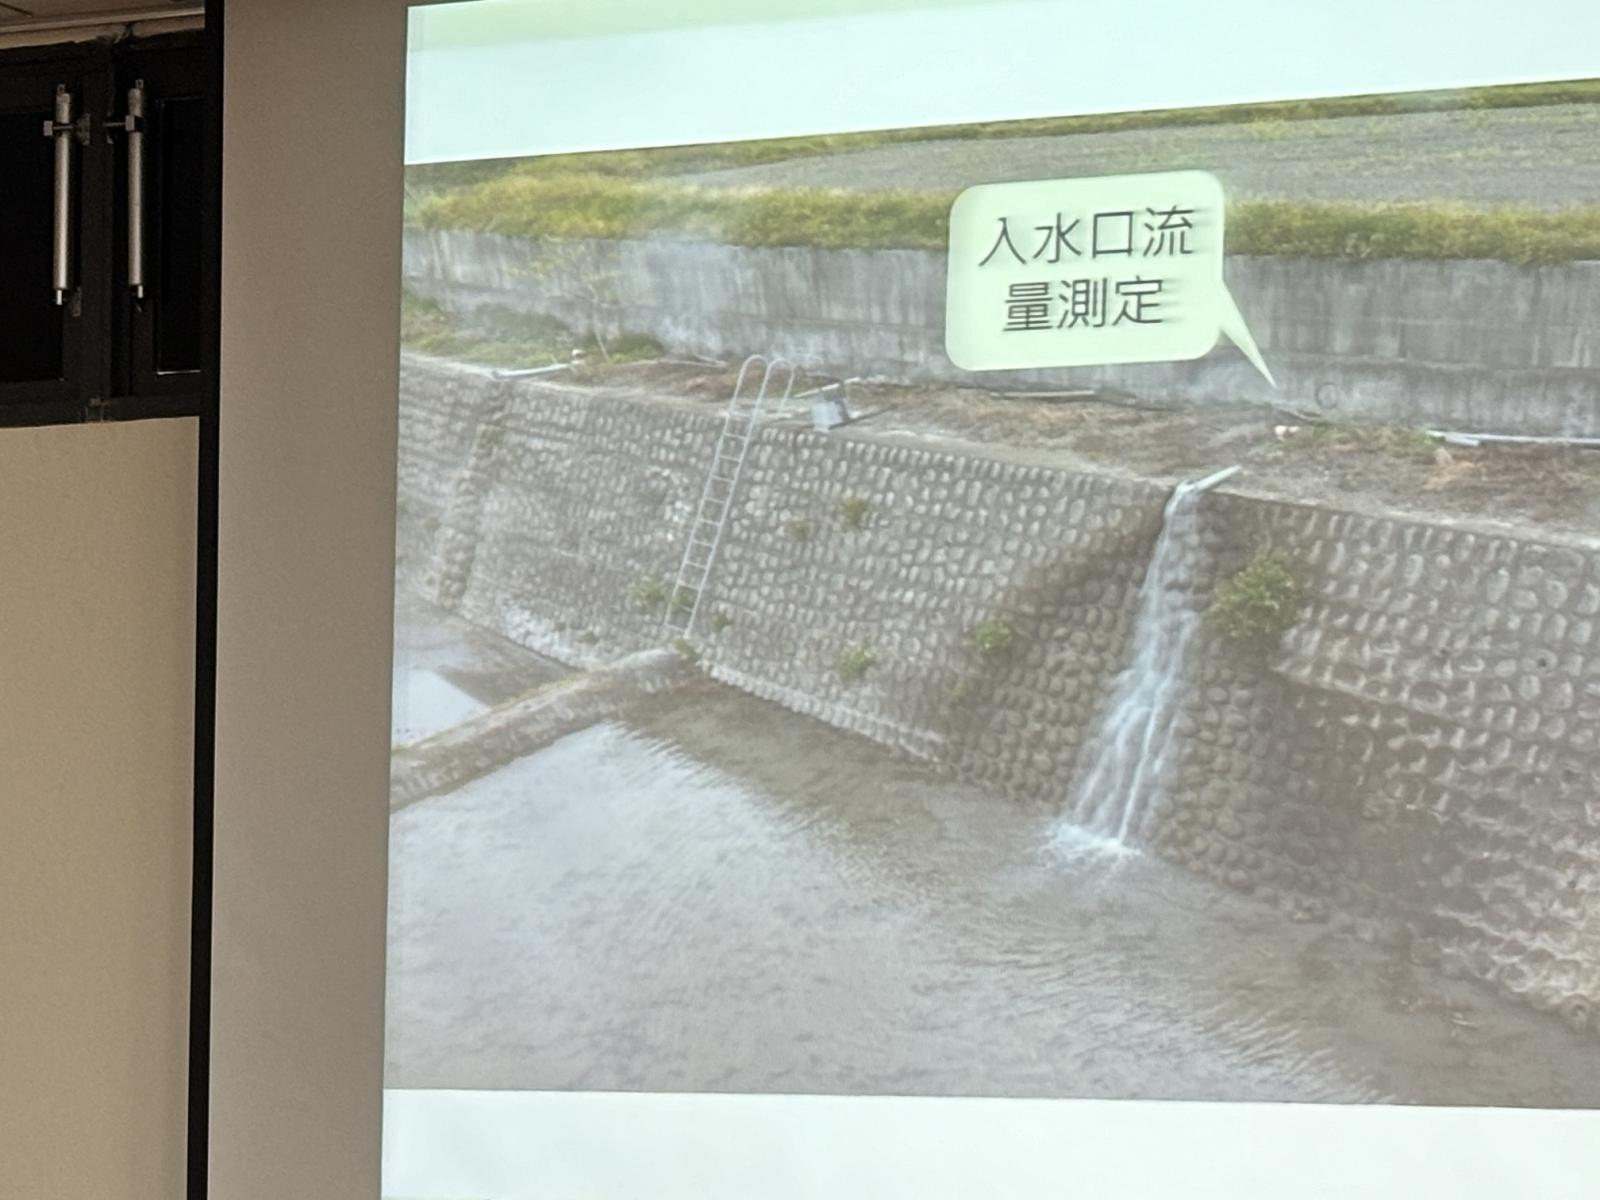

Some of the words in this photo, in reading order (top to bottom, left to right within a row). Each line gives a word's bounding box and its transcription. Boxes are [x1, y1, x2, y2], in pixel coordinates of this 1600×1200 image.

[978, 204, 1195, 267] 入水口流
[1002, 275, 1165, 332] 量測定
